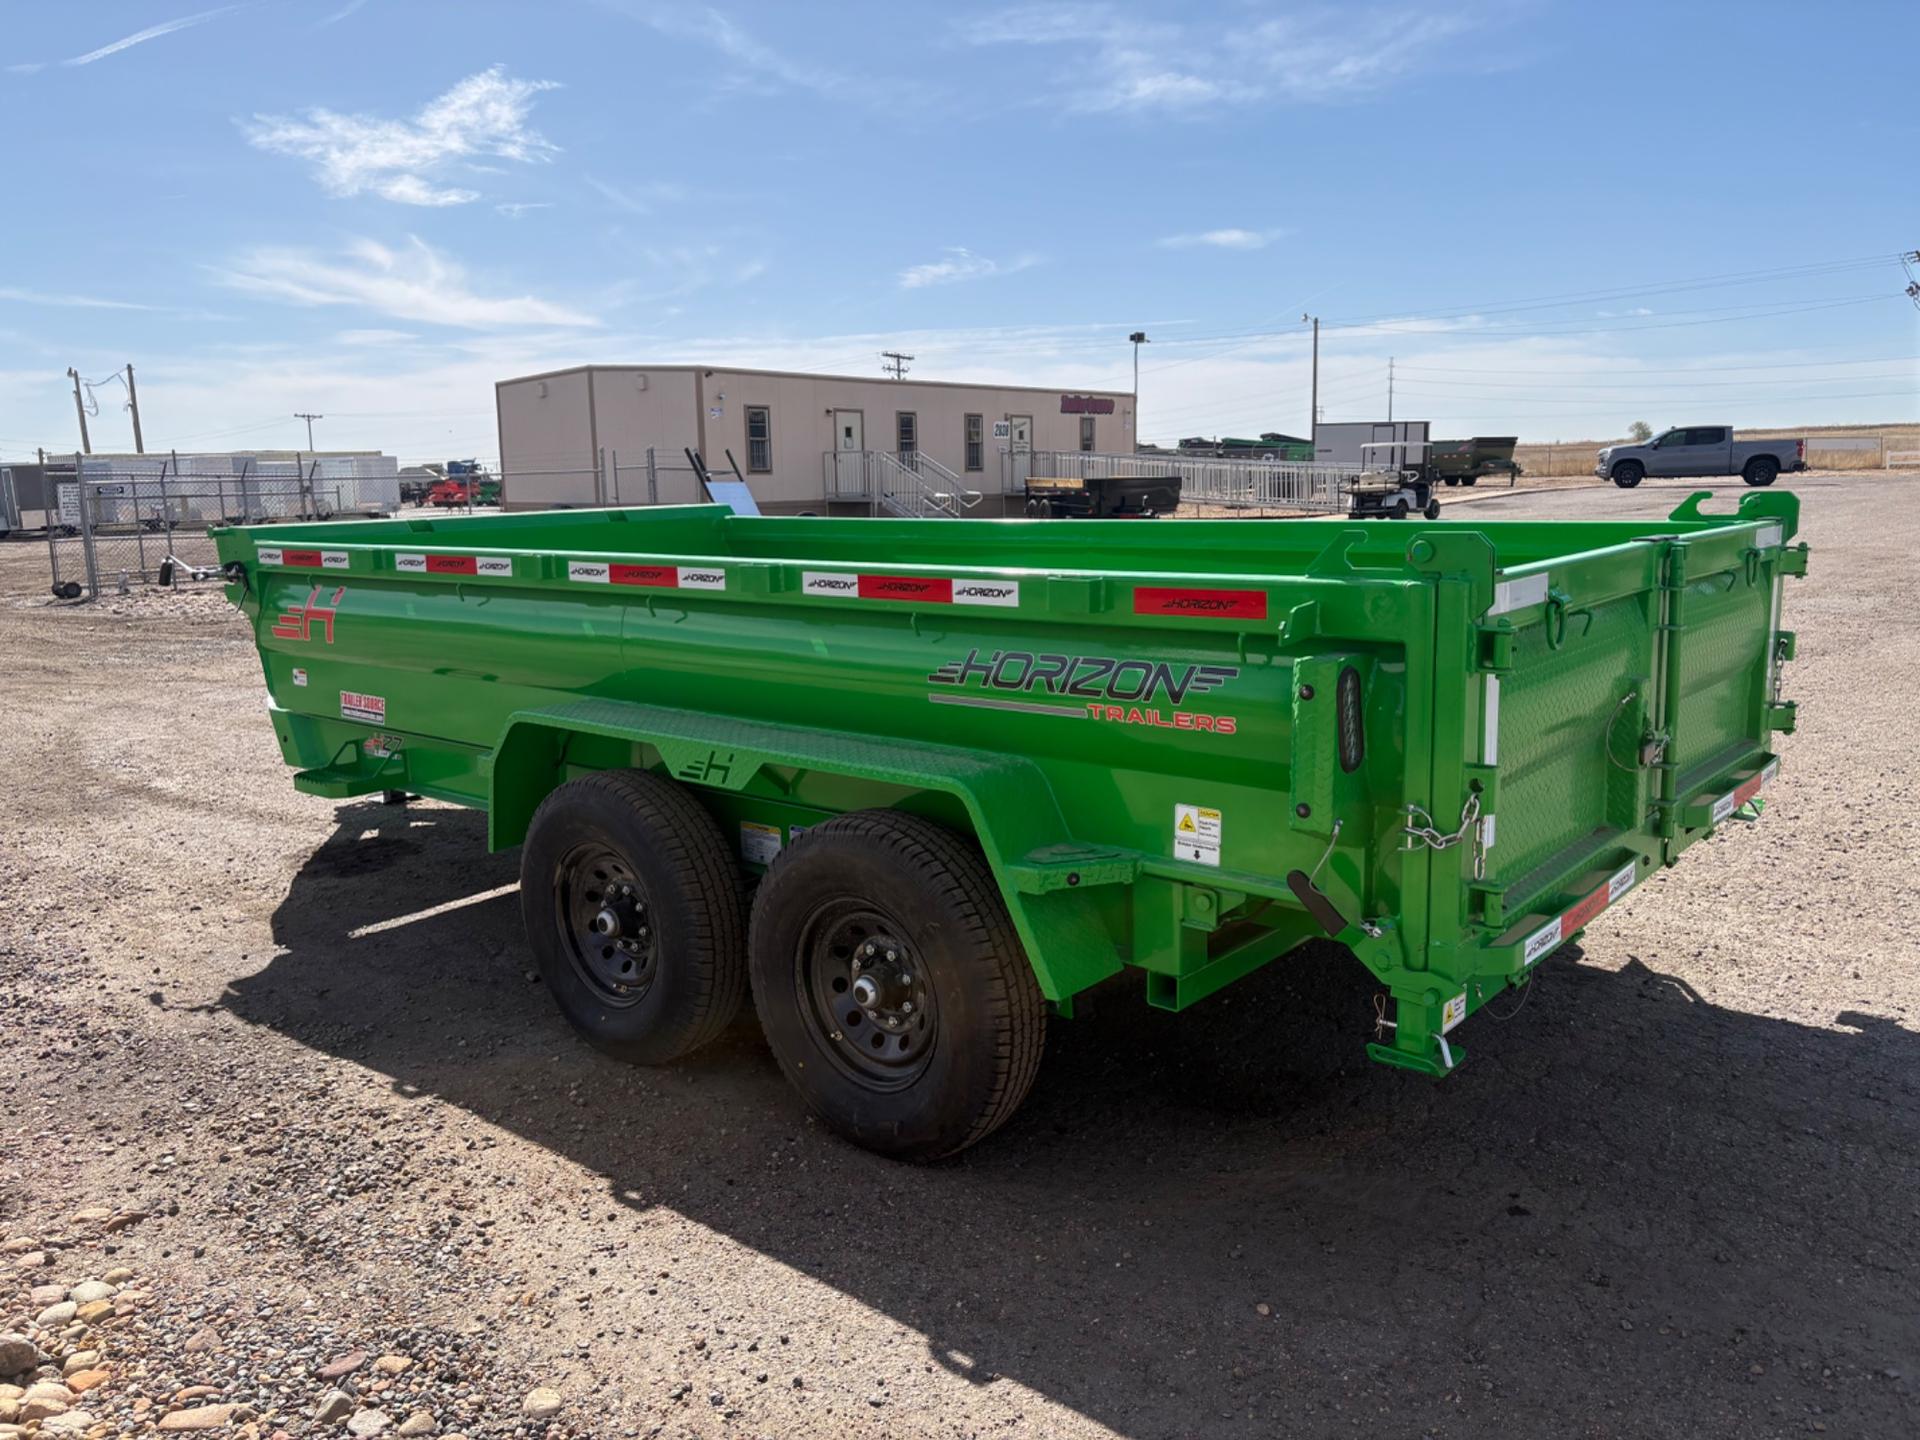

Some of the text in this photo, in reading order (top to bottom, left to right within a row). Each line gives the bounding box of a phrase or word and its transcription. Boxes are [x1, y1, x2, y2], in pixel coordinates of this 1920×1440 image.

[810, 578, 855, 589] HORIZON
[880, 583, 928, 593] HORIZON
[957, 587, 1011, 598] HORIZON
[1165, 598, 1235, 610] HORIZON
[950, 649, 1208, 705] HORIZON
[1086, 703, 1237, 734] TRAILERS
